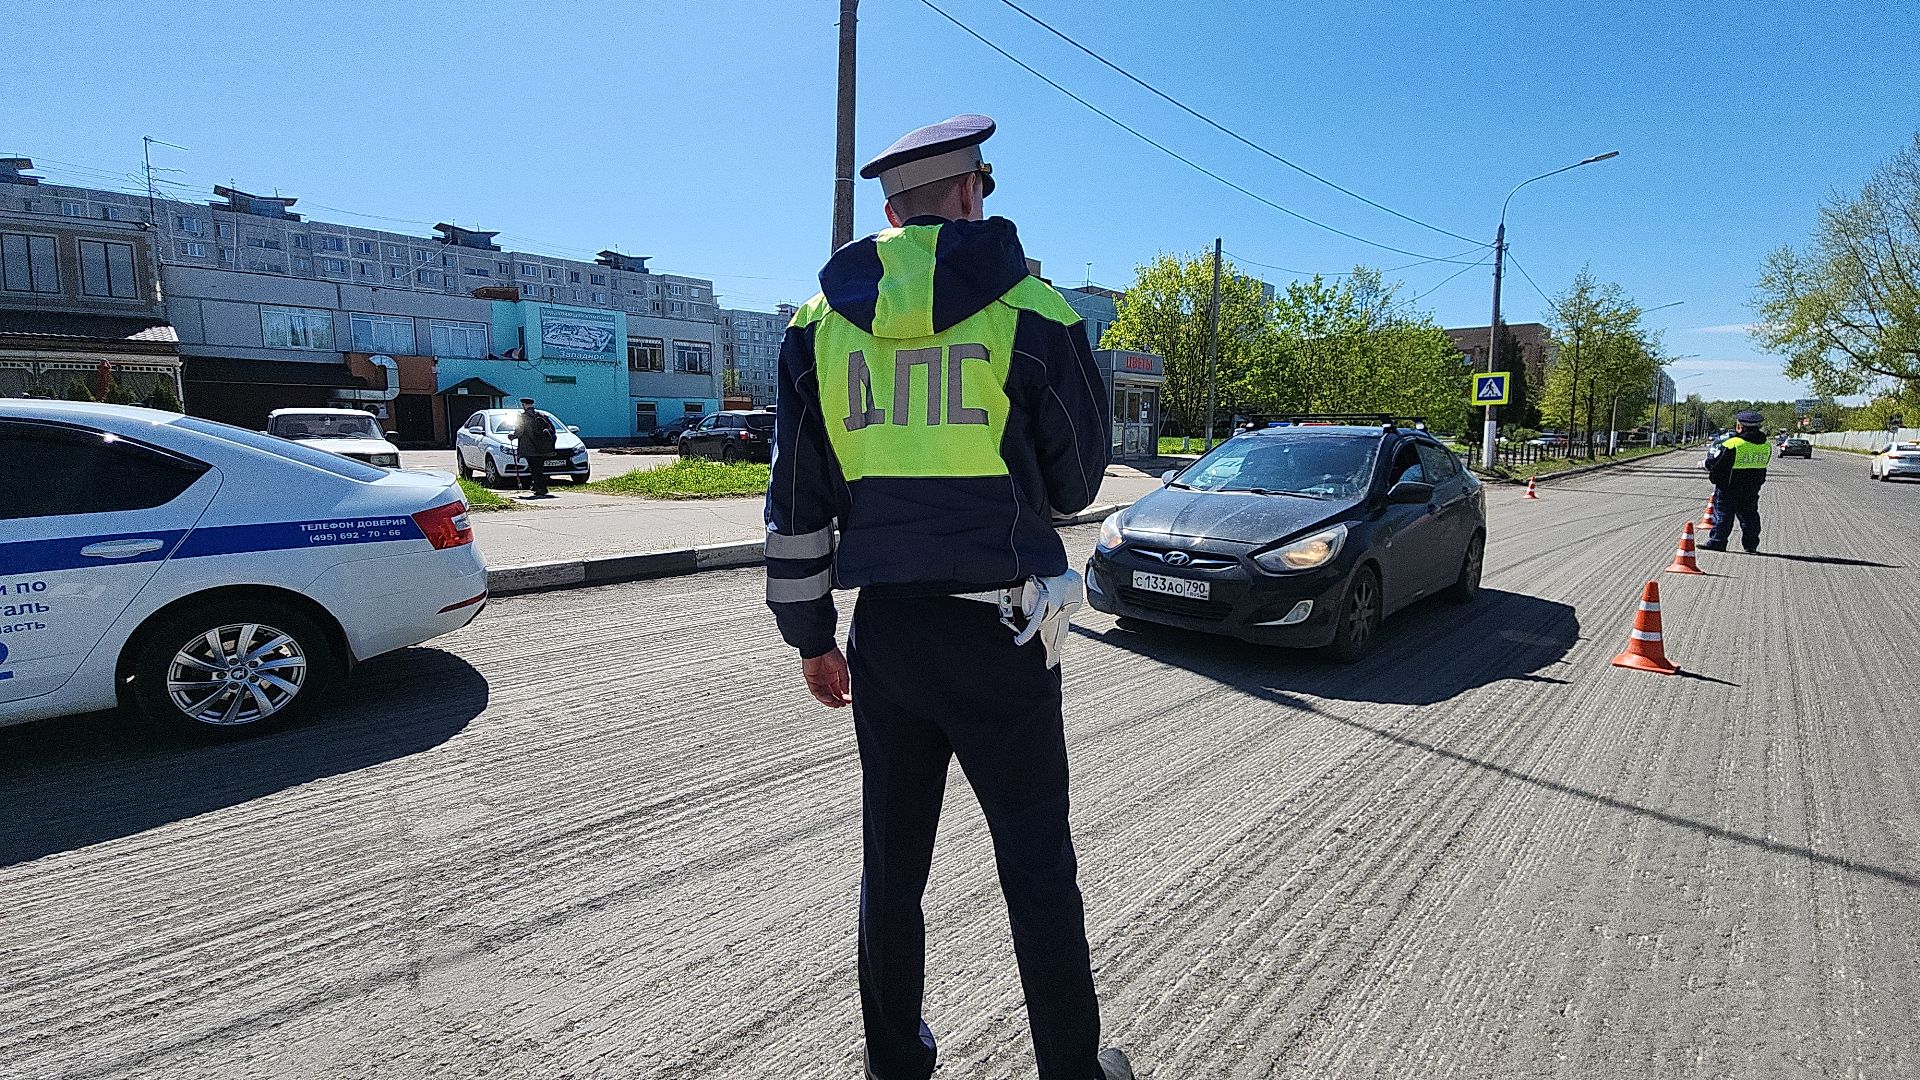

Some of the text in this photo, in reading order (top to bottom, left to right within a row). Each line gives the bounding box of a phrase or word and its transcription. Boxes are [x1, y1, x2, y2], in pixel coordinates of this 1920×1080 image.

[843, 343, 991, 432] ДПС
[299, 518, 407, 531] ТЕЛЕФОН ДОВЕРИЯ
[309, 533, 337, 543] (495)
[340, 531, 360, 540] 692
[368, 530, 380, 538] 70
[16, 581, 47, 594] по
[0, 602, 50, 617] аль
[0, 621, 46, 634] асть
